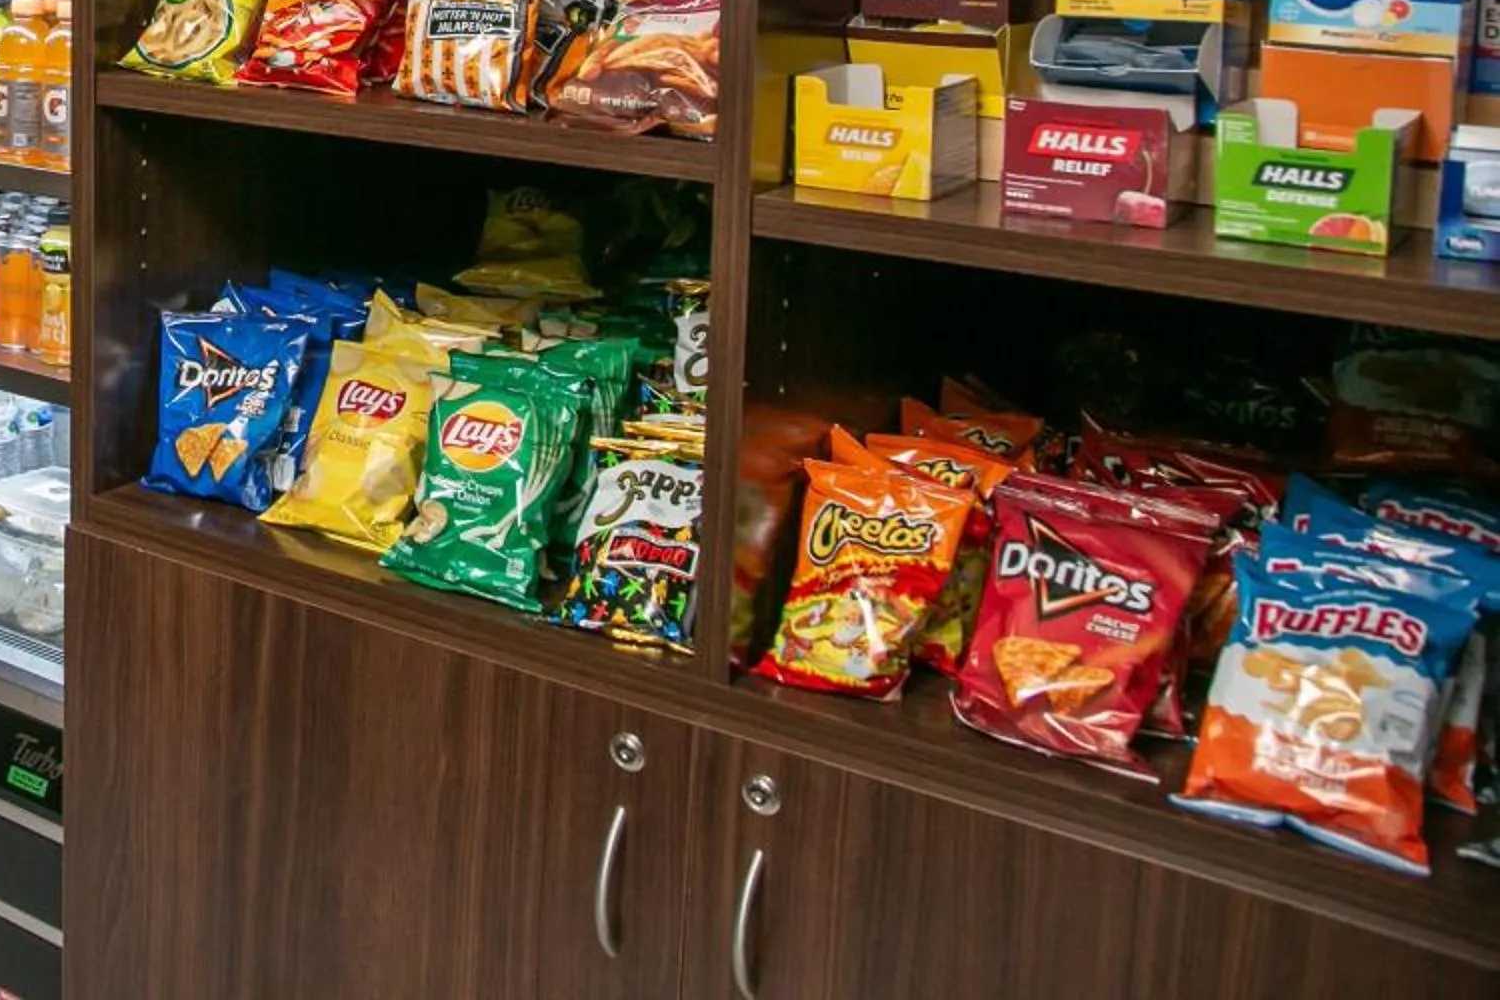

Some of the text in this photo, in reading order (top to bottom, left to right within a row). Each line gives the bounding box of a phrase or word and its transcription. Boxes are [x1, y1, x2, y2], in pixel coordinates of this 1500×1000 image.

[828, 126, 897, 148] HALLS
[1036, 130, 1131, 156] HALLS
[1052, 158, 1112, 177] RELIEF
[1260, 165, 1346, 189] HALLS
[1265, 190, 1339, 209] DEFENSE
[180, 358, 279, 391] Doritos
[340, 380, 406, 414] Lay's
[443, 415, 522, 453] Lay's
[594, 469, 702, 526] Zapp
[810, 502, 933, 560] Cheetos
[999, 541, 1155, 612] Doritos
[1256, 599, 1427, 655] RUFFLES
